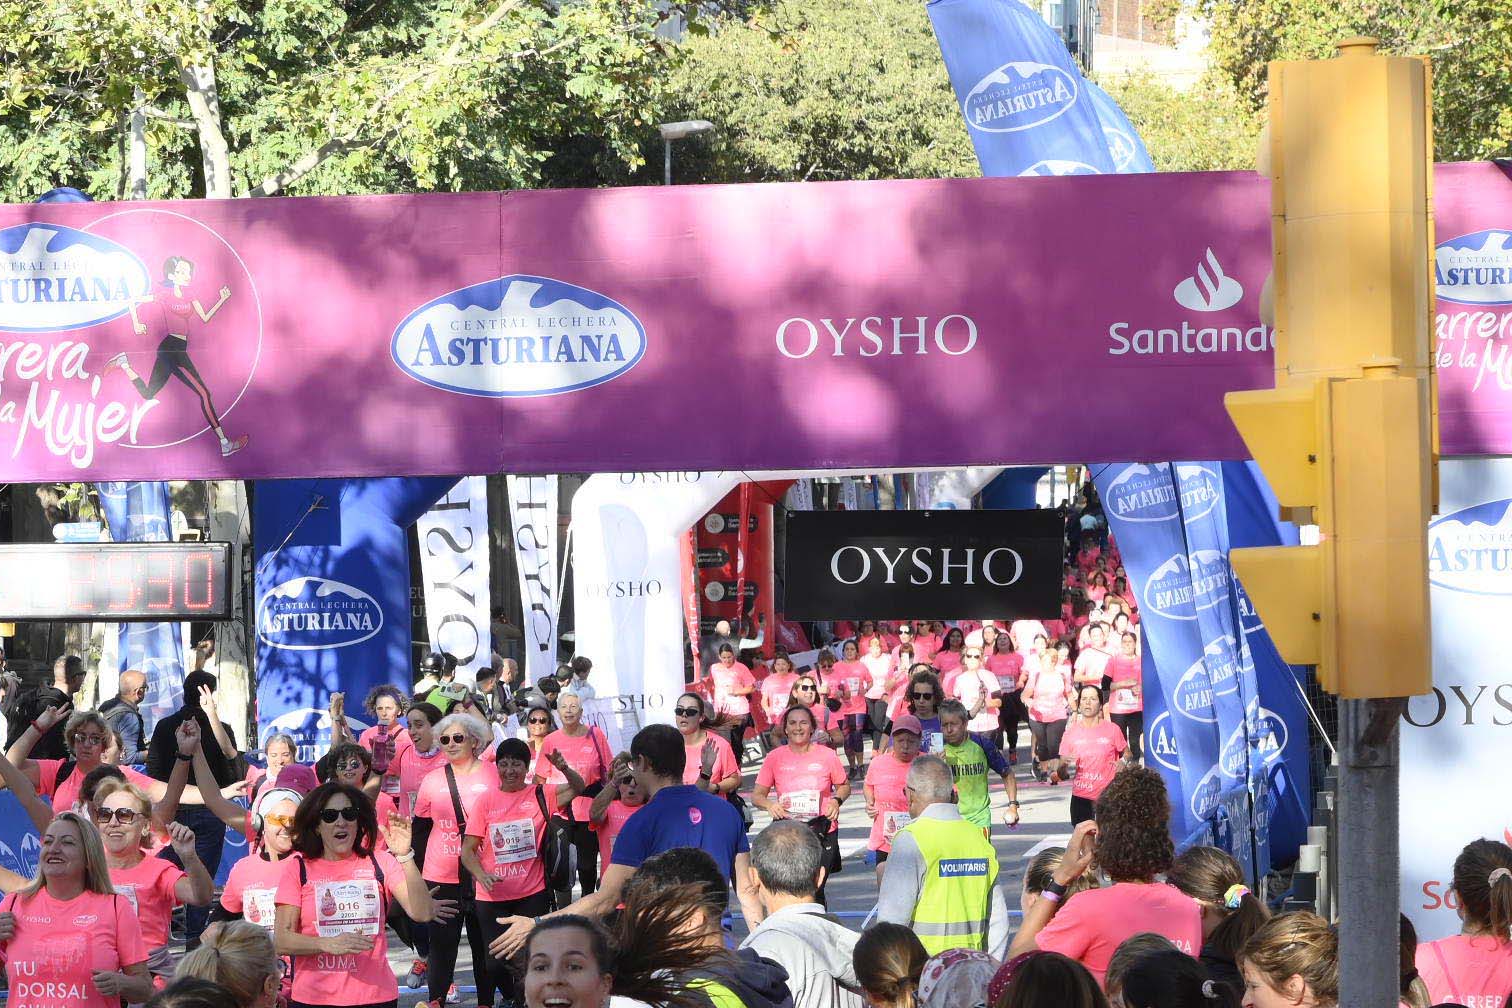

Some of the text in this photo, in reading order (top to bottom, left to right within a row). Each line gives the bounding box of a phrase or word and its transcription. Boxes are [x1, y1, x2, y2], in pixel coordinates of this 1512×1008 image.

[450, 315, 617, 331] CENTRAL LECHERA
[411, 323, 626, 367] ASTURIANA
[775, 314, 978, 359] OYSHO
[11, 374, 160, 469] Mujer
[830, 545, 1024, 586] OYSHO
[587, 579, 662, 599] OYSHO
[274, 601, 370, 610] CENTRAL LECHERA
[261, 607, 374, 633] ASTURIANA
[494, 865, 527, 878] SUMA
[338, 901, 360, 911] 016
[13, 961, 36, 976] TU
[317, 955, 357, 970] SUMA
[18, 982, 88, 1000] DORSAL
